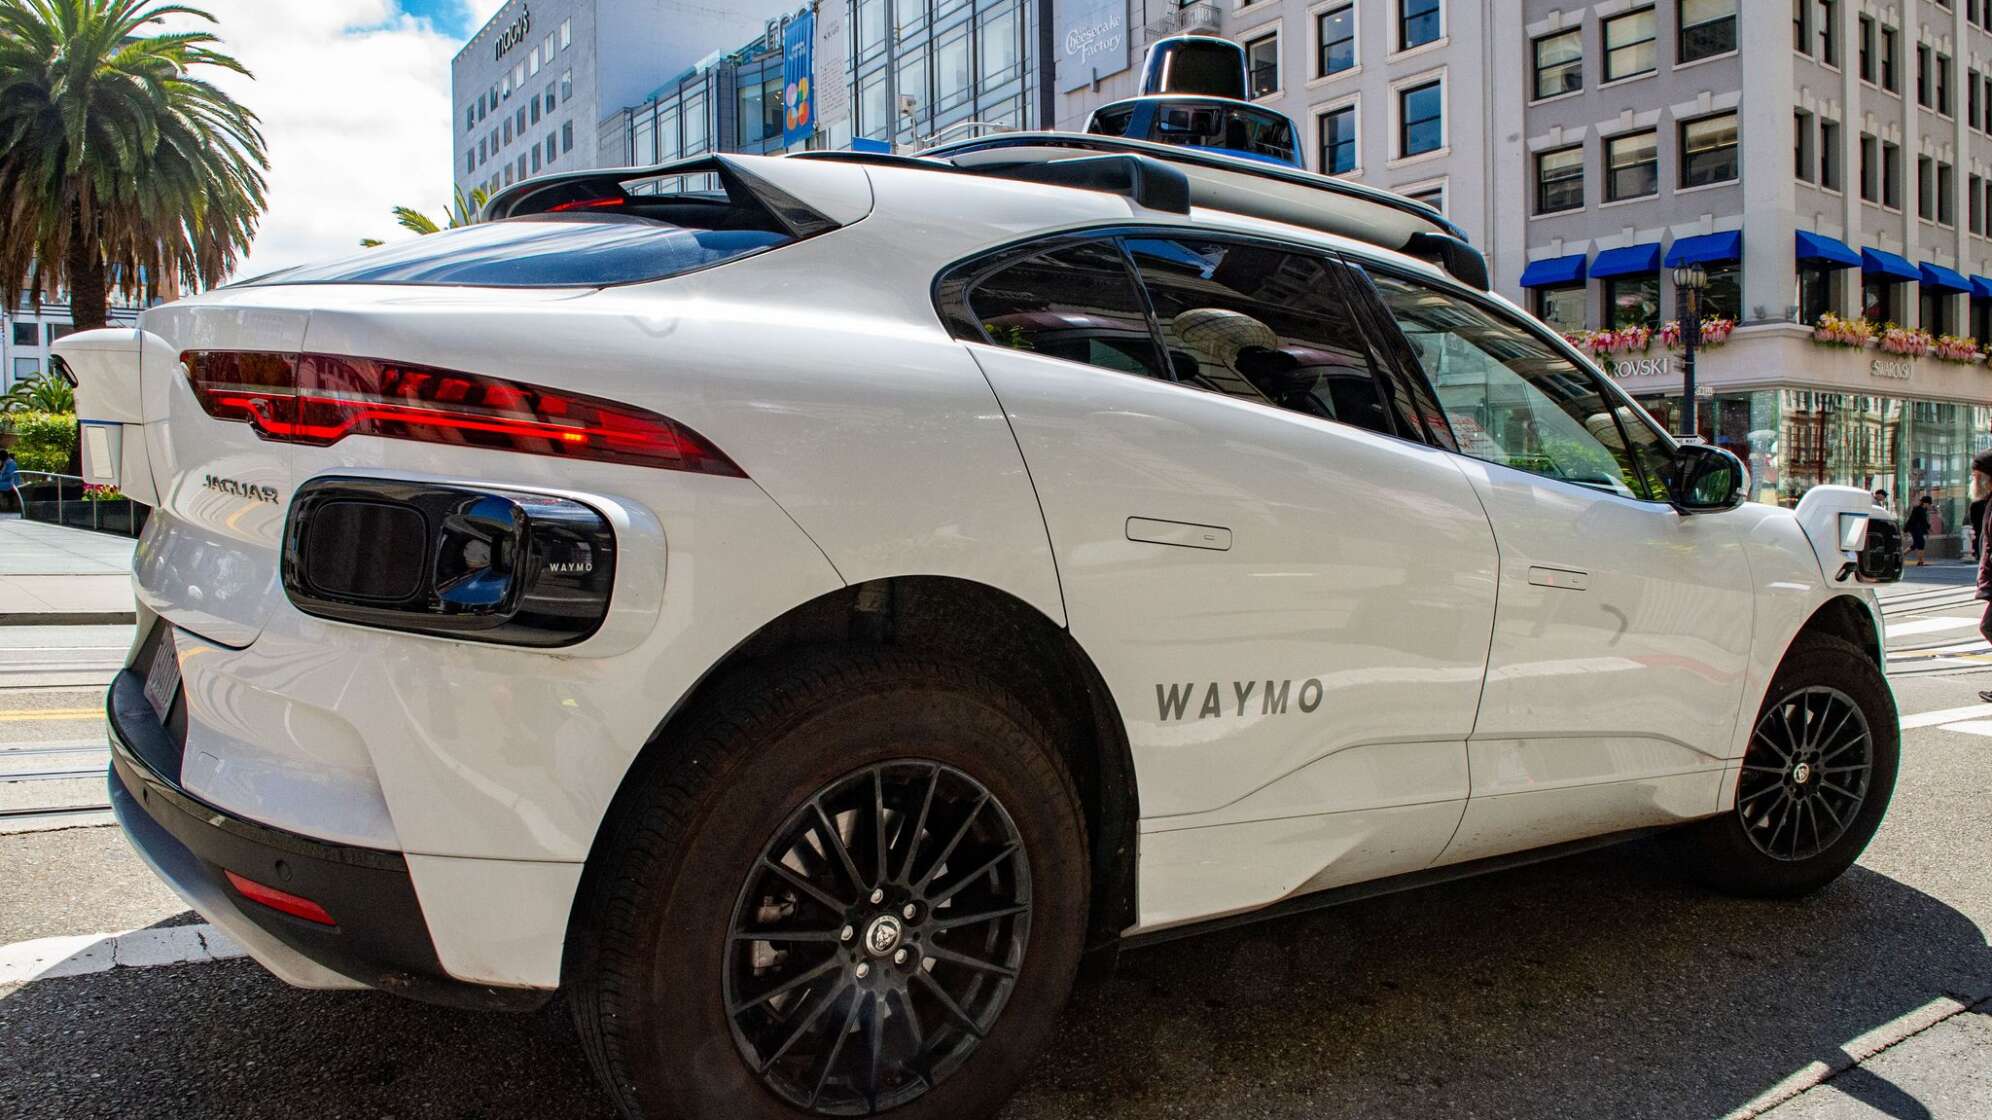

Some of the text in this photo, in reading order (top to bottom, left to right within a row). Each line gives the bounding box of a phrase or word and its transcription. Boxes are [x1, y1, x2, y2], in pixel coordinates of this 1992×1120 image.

[1066, 15, 1120, 55] Cheesecake
[1077, 34, 1121, 64] Factory
[202, 475, 279, 504] JAGUAR
[549, 562, 593, 572] WAYMO
[1155, 678, 1323, 721] WAYMO
